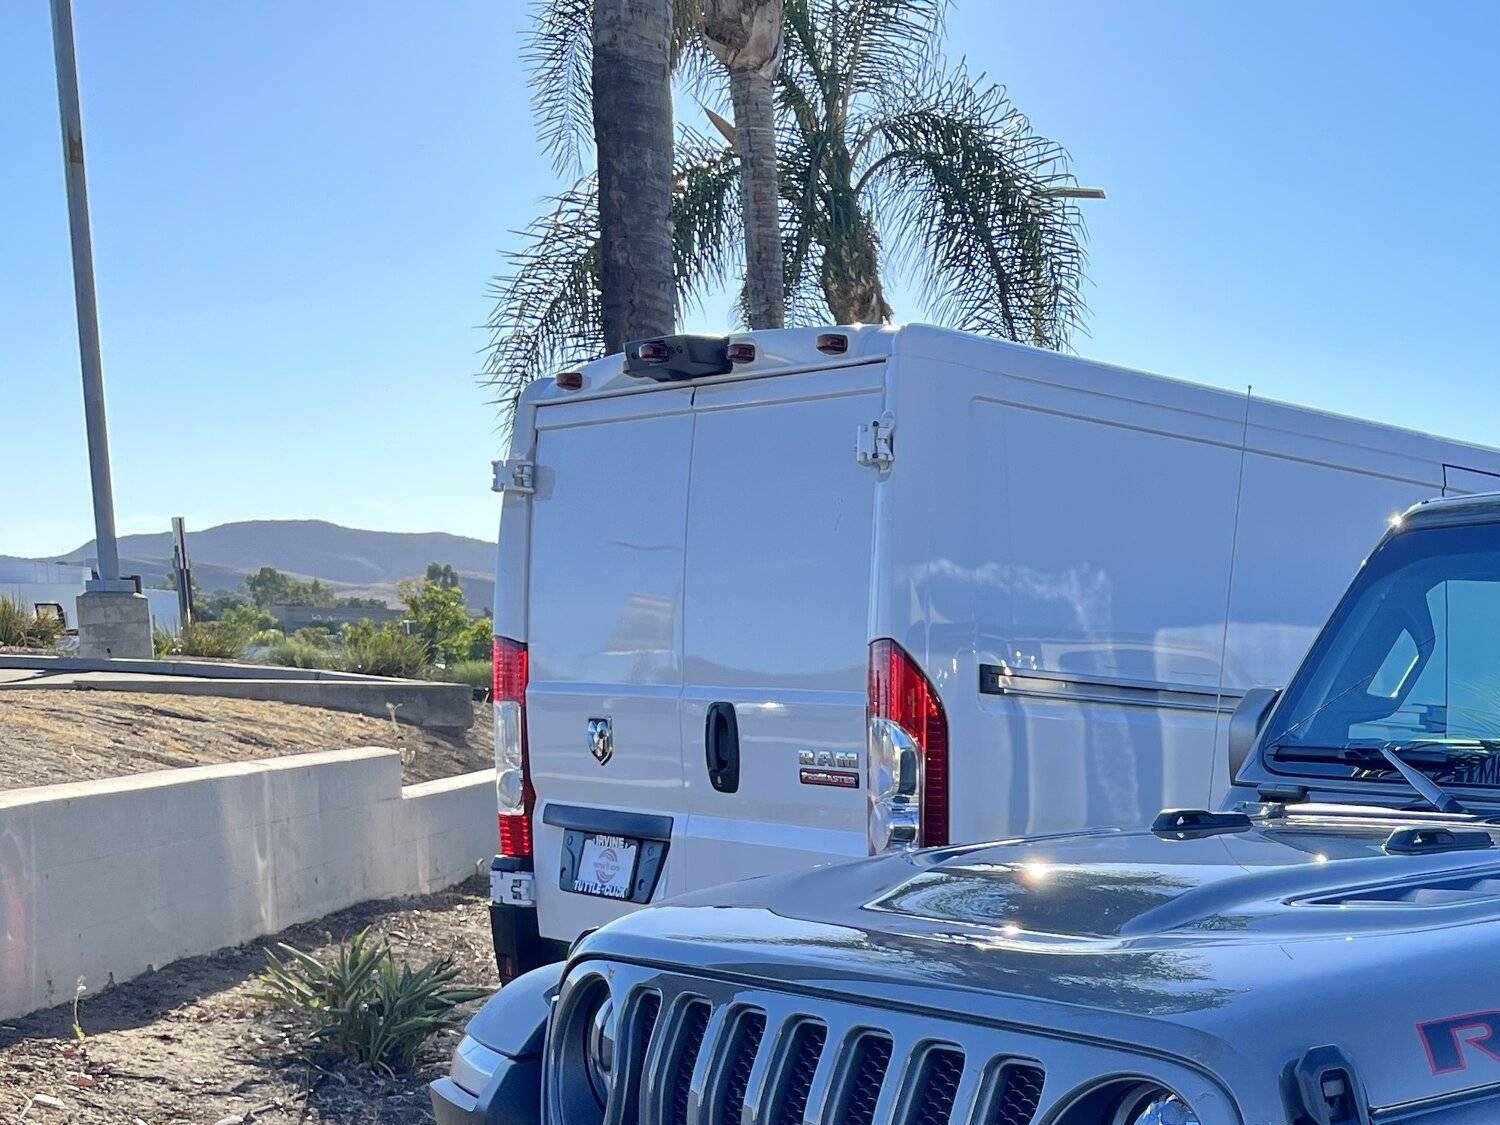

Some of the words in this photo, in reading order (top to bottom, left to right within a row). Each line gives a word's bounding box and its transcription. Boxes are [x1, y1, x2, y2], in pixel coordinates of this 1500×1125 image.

[798, 750, 859, 768] RAM
[596, 835, 625, 848] IRVINE
[574, 880, 626, 898] TUTTLE-CLICK
